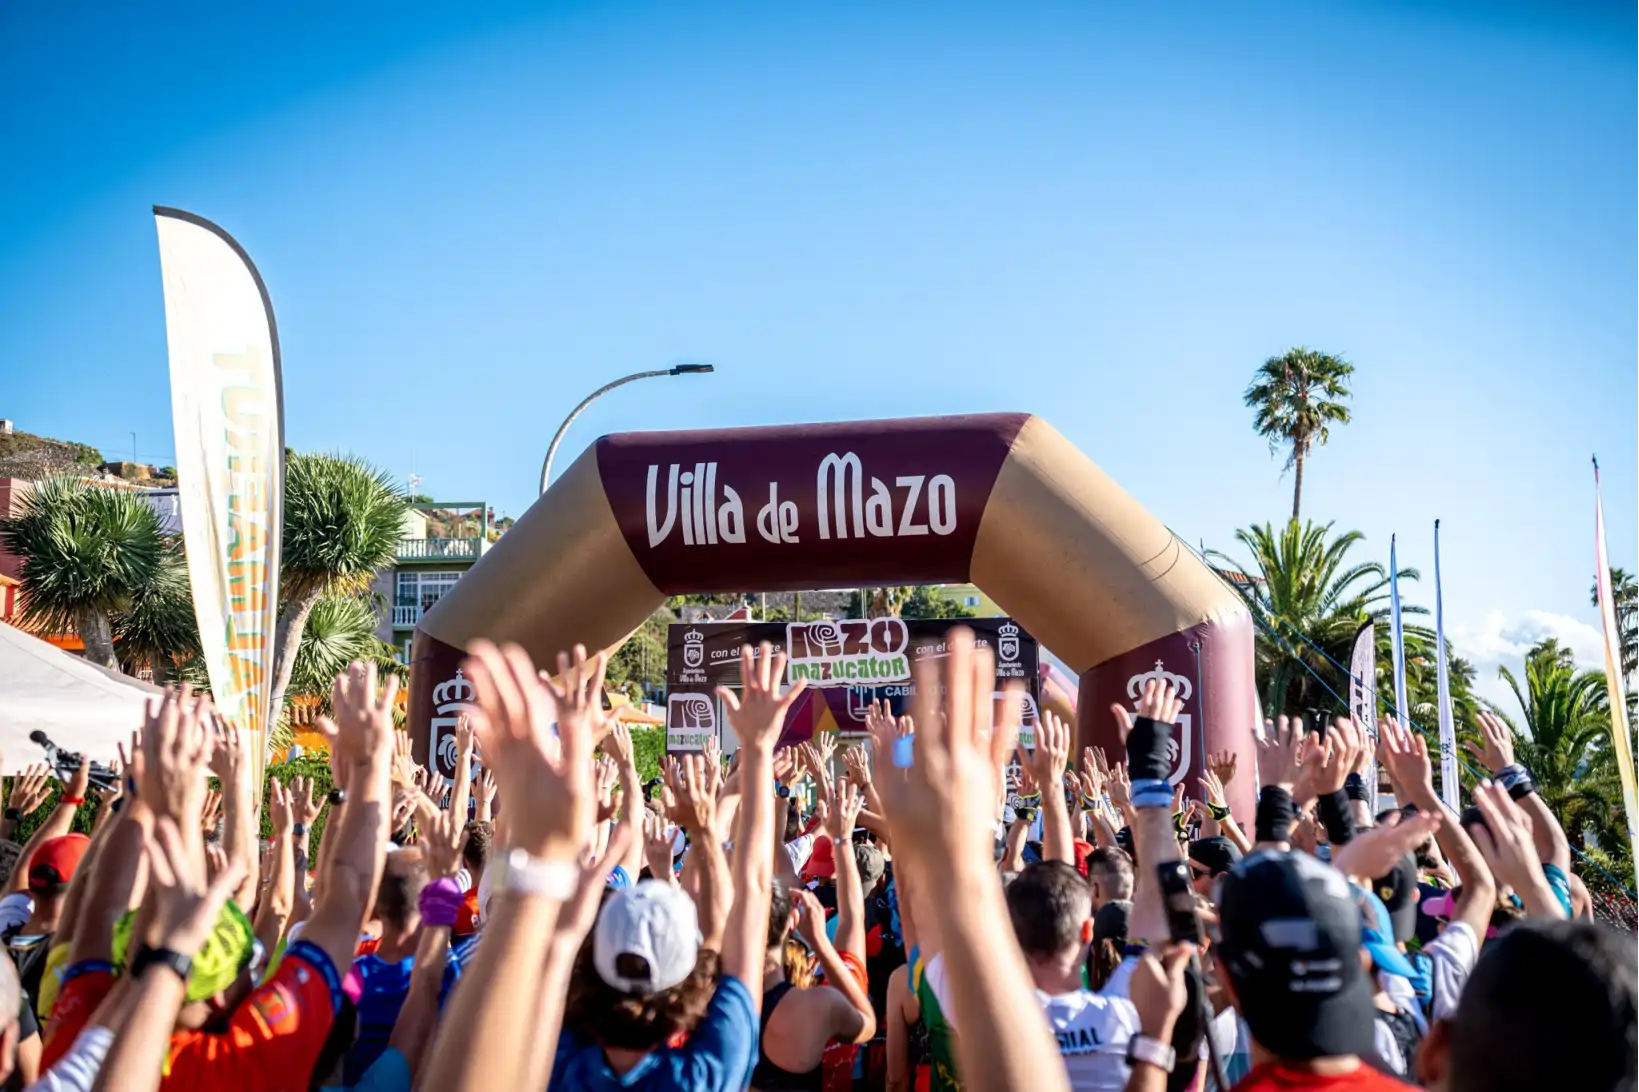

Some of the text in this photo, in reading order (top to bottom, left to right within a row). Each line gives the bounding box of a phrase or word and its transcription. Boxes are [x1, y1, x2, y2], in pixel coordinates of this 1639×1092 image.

[646, 451, 957, 548] Villa de Mazo
[711, 648, 728, 658] con
[731, 646, 740, 656] el
[916, 645, 934, 655] con
[936, 643, 945, 652] el
